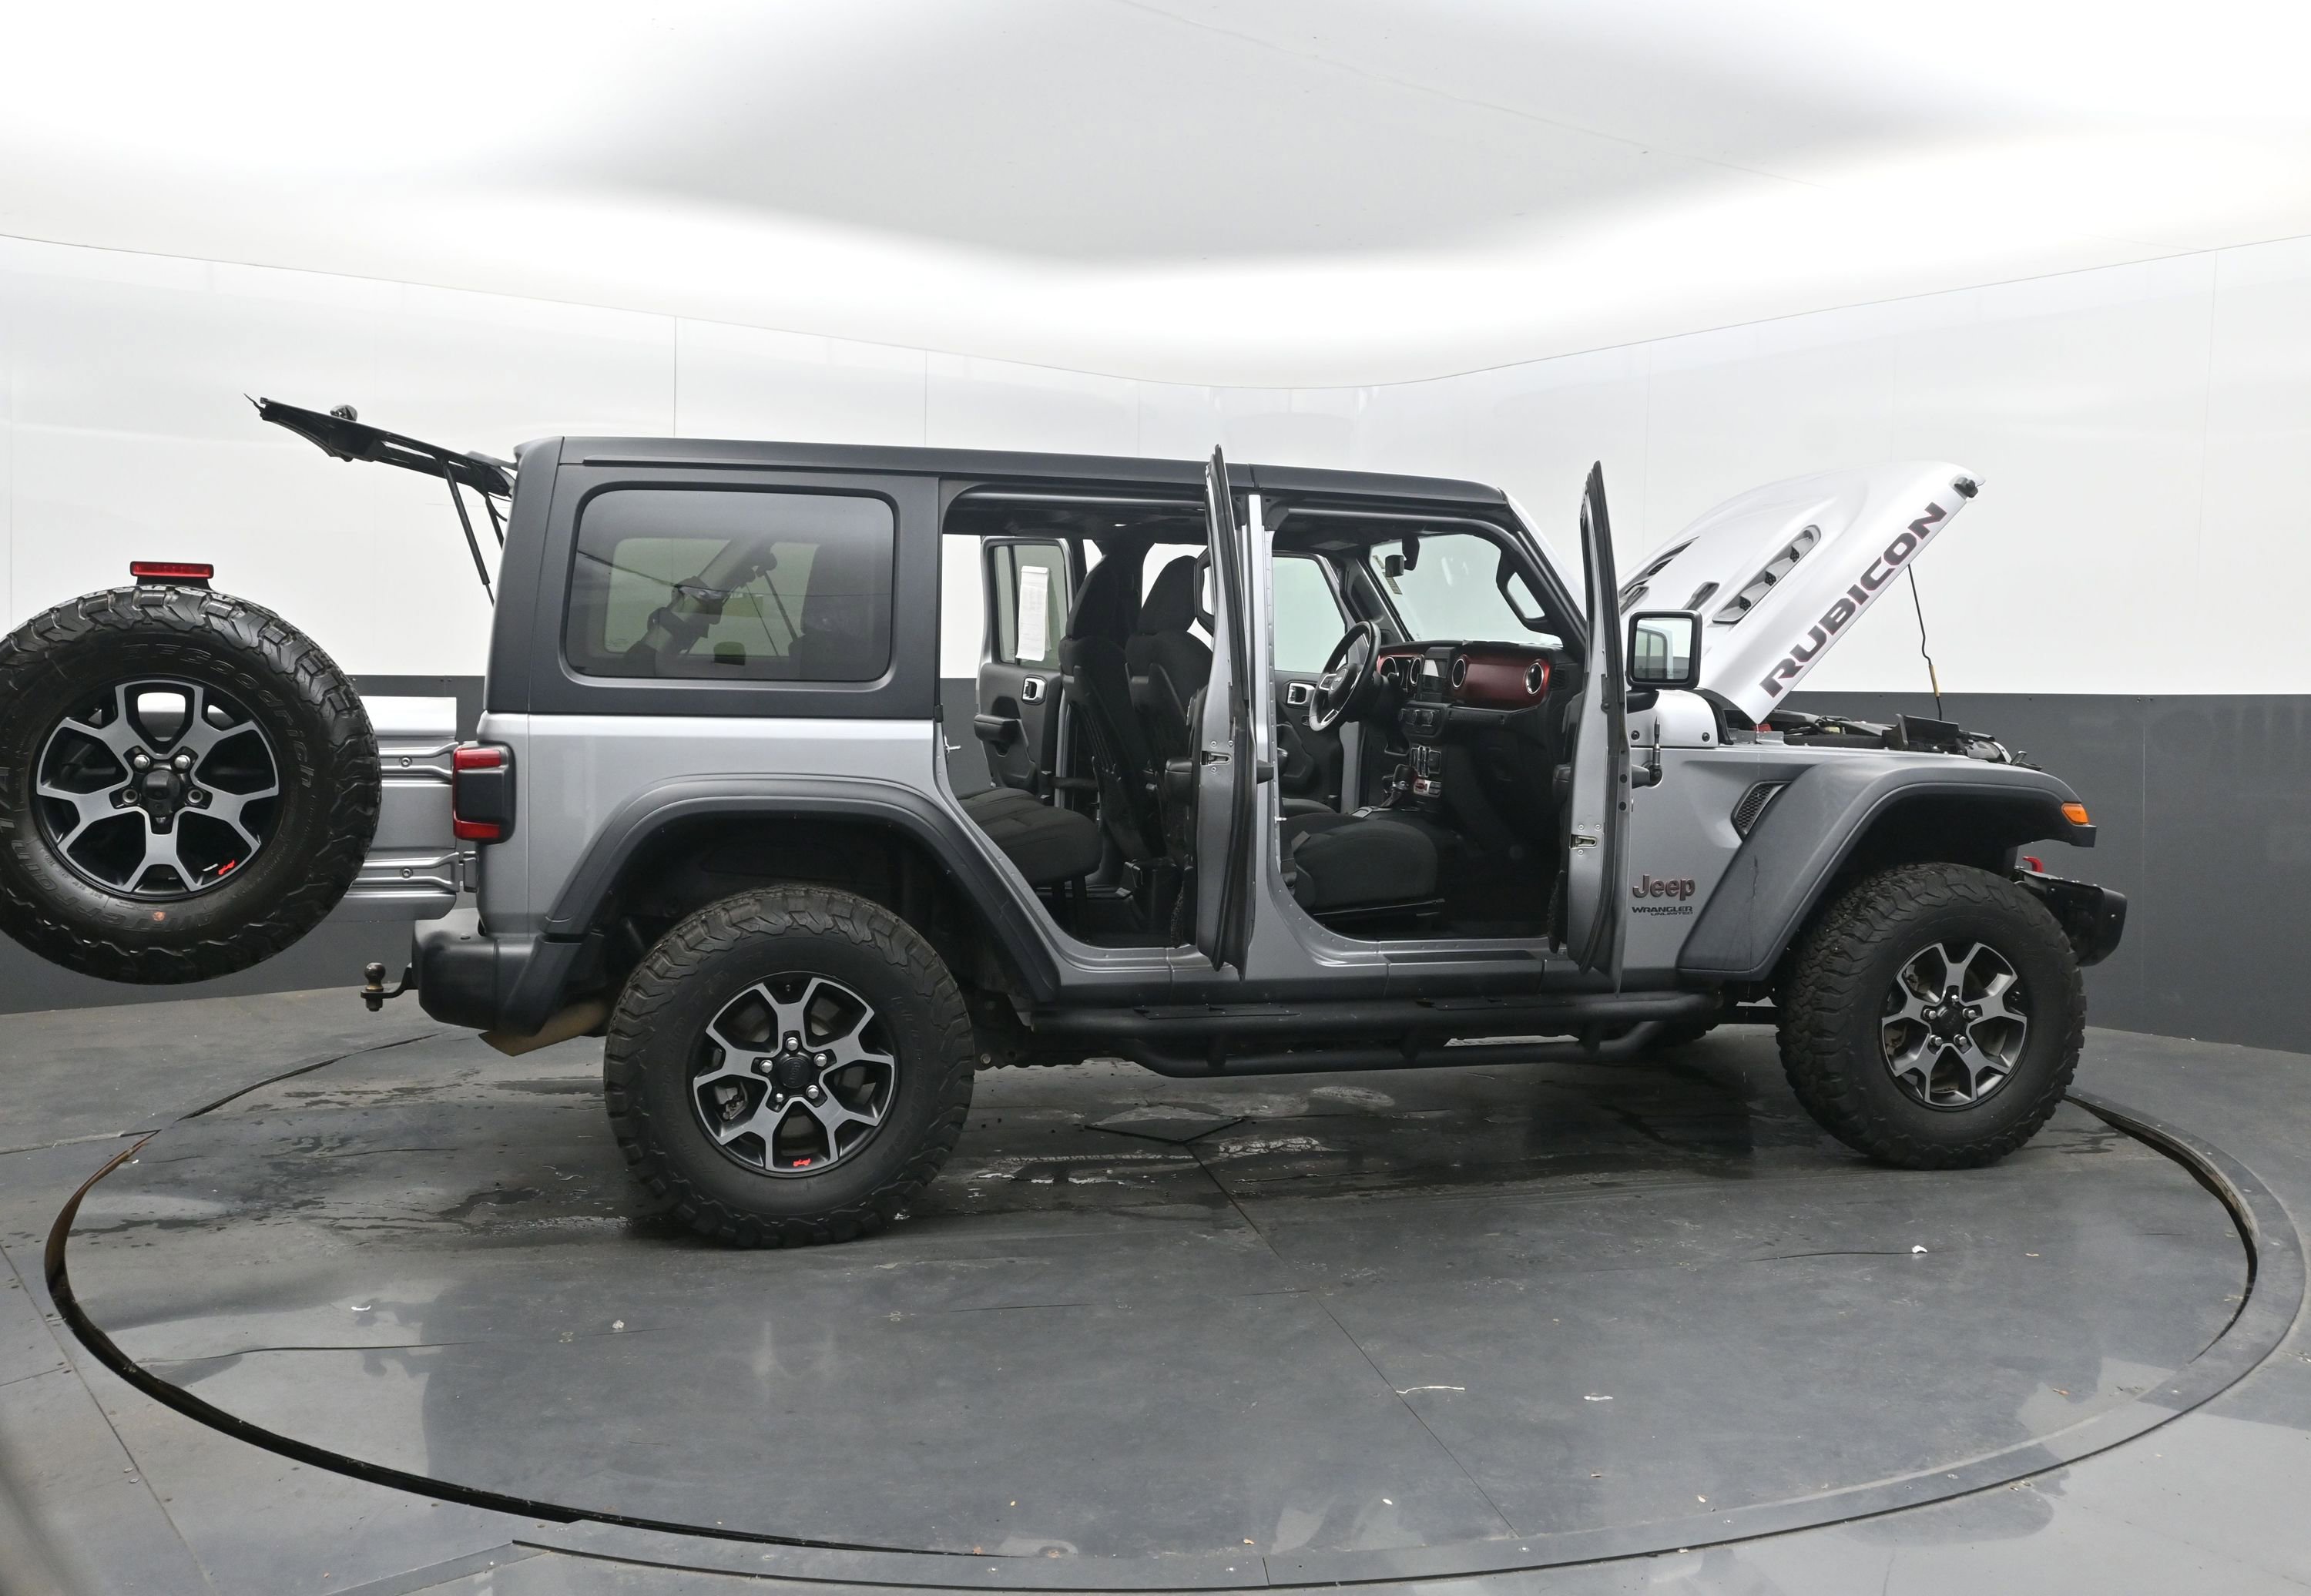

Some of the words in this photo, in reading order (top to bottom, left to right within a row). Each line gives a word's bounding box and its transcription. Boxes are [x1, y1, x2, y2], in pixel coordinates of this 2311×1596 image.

[1759, 501, 1948, 699] RUBICON
[1632, 873, 1696, 901] Jeep
[1632, 905, 1693, 914] WRANGLER
